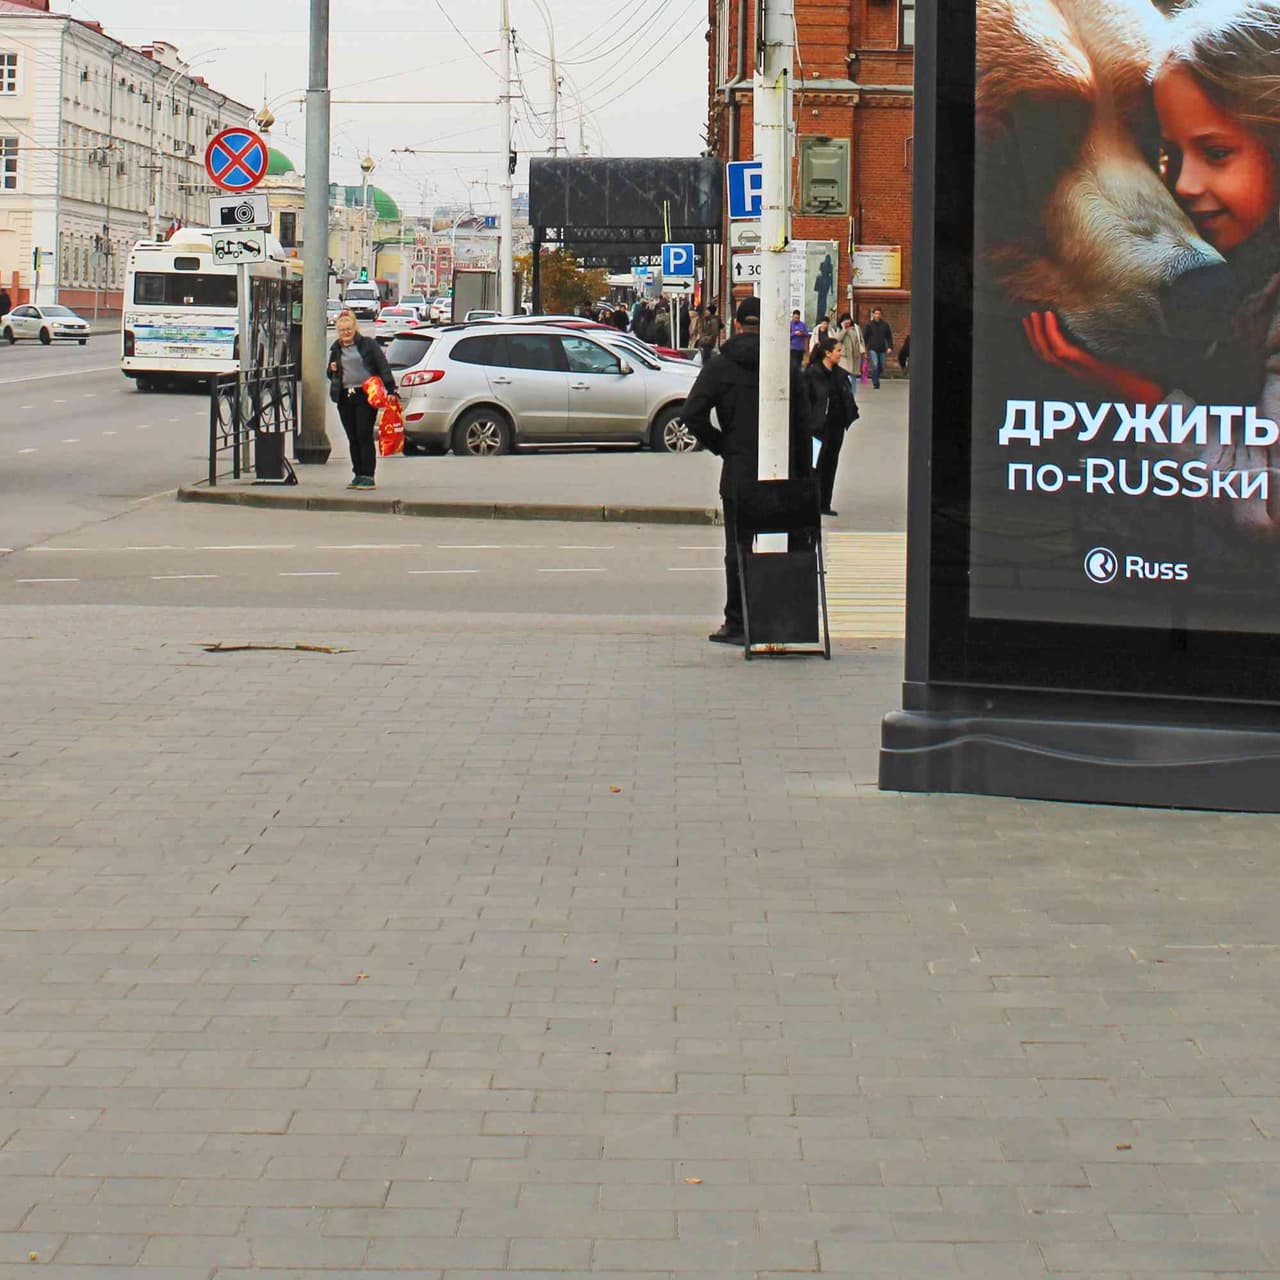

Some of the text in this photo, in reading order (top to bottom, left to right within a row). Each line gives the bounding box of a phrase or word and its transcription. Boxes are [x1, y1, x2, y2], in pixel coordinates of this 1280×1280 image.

[669, 247, 687, 273] P
[998, 399, 1280, 447] ДРУЖИТЬ
[1007, 457, 1270, 500] по-RUSSки
[1125, 555, 1189, 581] Russ
